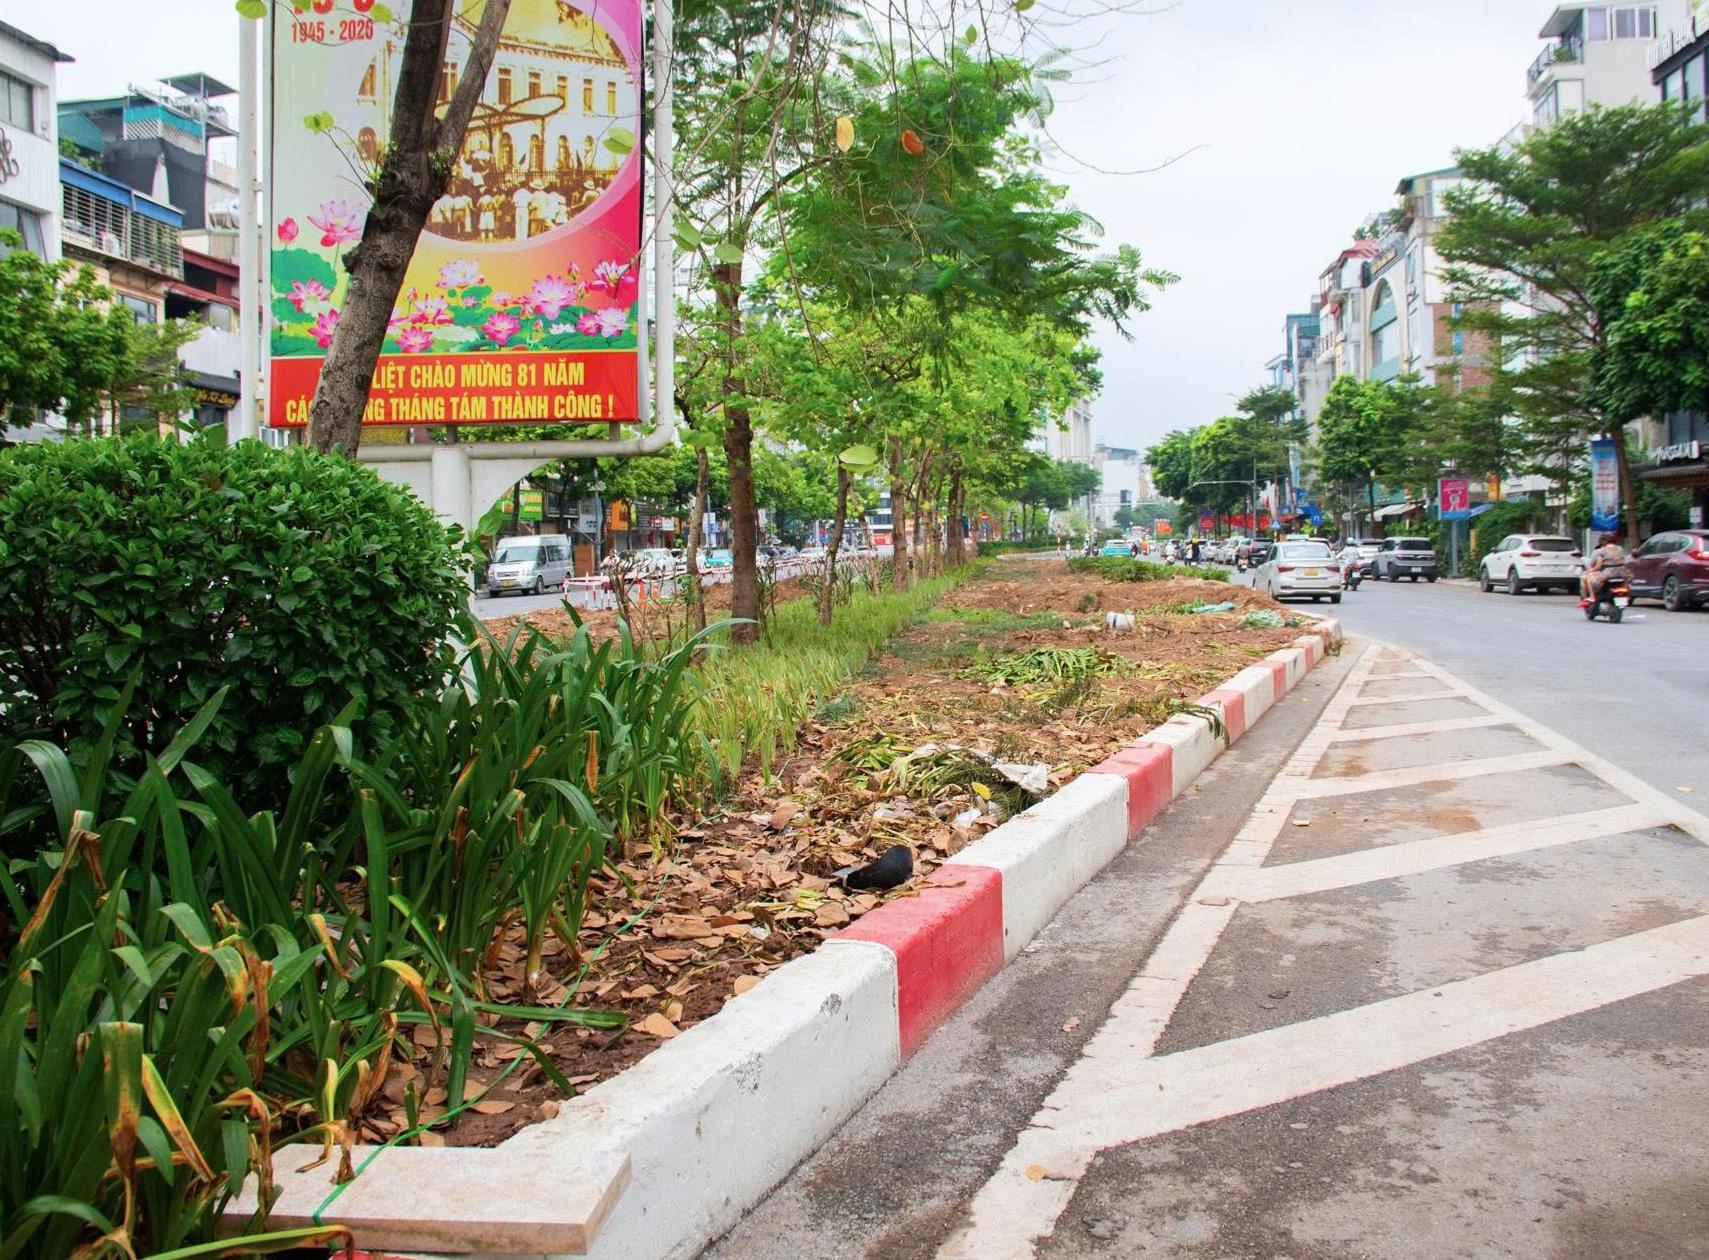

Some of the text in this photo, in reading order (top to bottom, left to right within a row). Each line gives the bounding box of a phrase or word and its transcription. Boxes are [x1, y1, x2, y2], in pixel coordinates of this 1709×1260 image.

[291, 21, 325, 43] 1945
[411, 360, 456, 388] CHÀO
[461, 359, 513, 387] MỪNG
[517, 363, 537, 387] 81
[543, 358, 585, 386] NĂM
[286, 394, 313, 423] CÁ
[389, 393, 445, 421] THÁNG
[450, 393, 487, 420] TÁM
[492, 391, 549, 419] THÀNH
[553, 390, 602, 419] CÔNG
[607, 394, 614, 418] !
